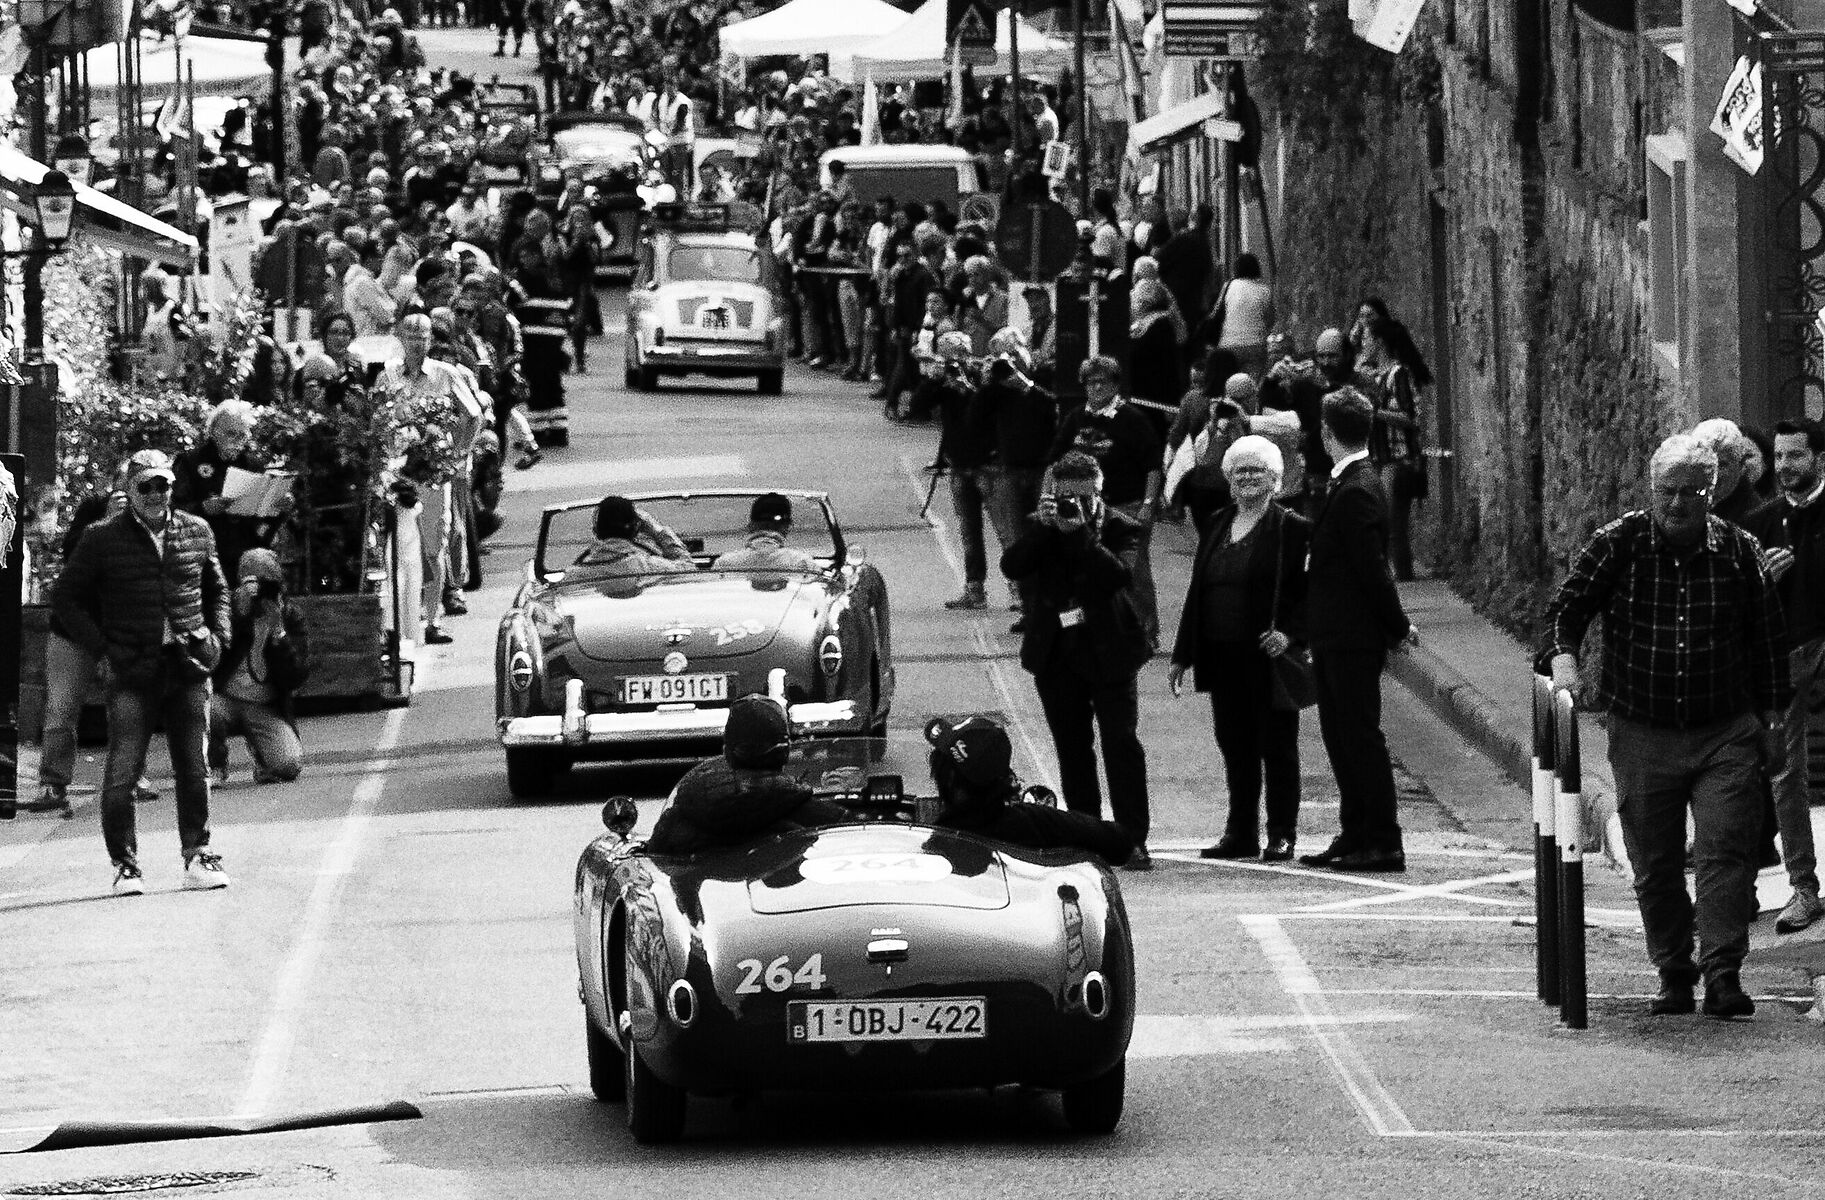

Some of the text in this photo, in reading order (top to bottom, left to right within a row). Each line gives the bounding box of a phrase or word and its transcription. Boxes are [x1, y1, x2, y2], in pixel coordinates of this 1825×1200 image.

[831, 858, 920, 872] 264
[735, 953, 827, 994] 264
[793, 1024, 805, 1039] B
